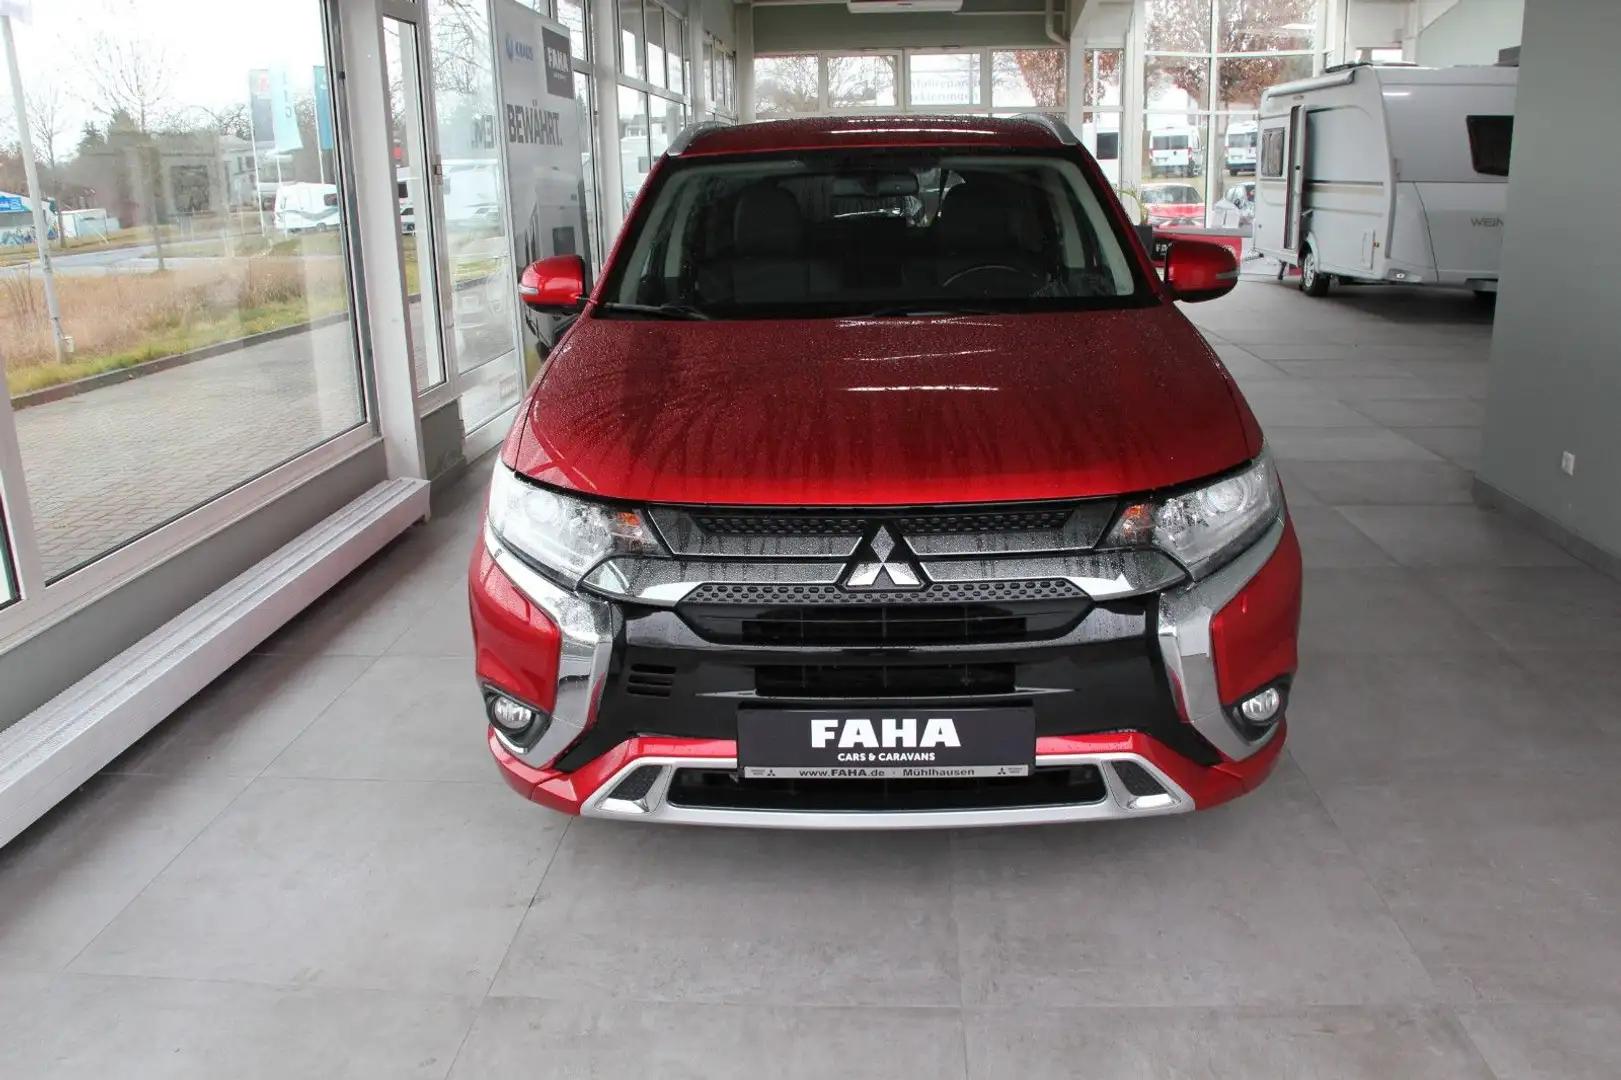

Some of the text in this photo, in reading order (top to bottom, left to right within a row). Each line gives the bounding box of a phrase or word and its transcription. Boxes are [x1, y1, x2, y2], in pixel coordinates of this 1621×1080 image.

[811, 719, 961, 748] FAHA
[837, 752, 936, 762] CARS & CARAVANS
[799, 768, 975, 777] www.FAHA.de Mühlhausen
